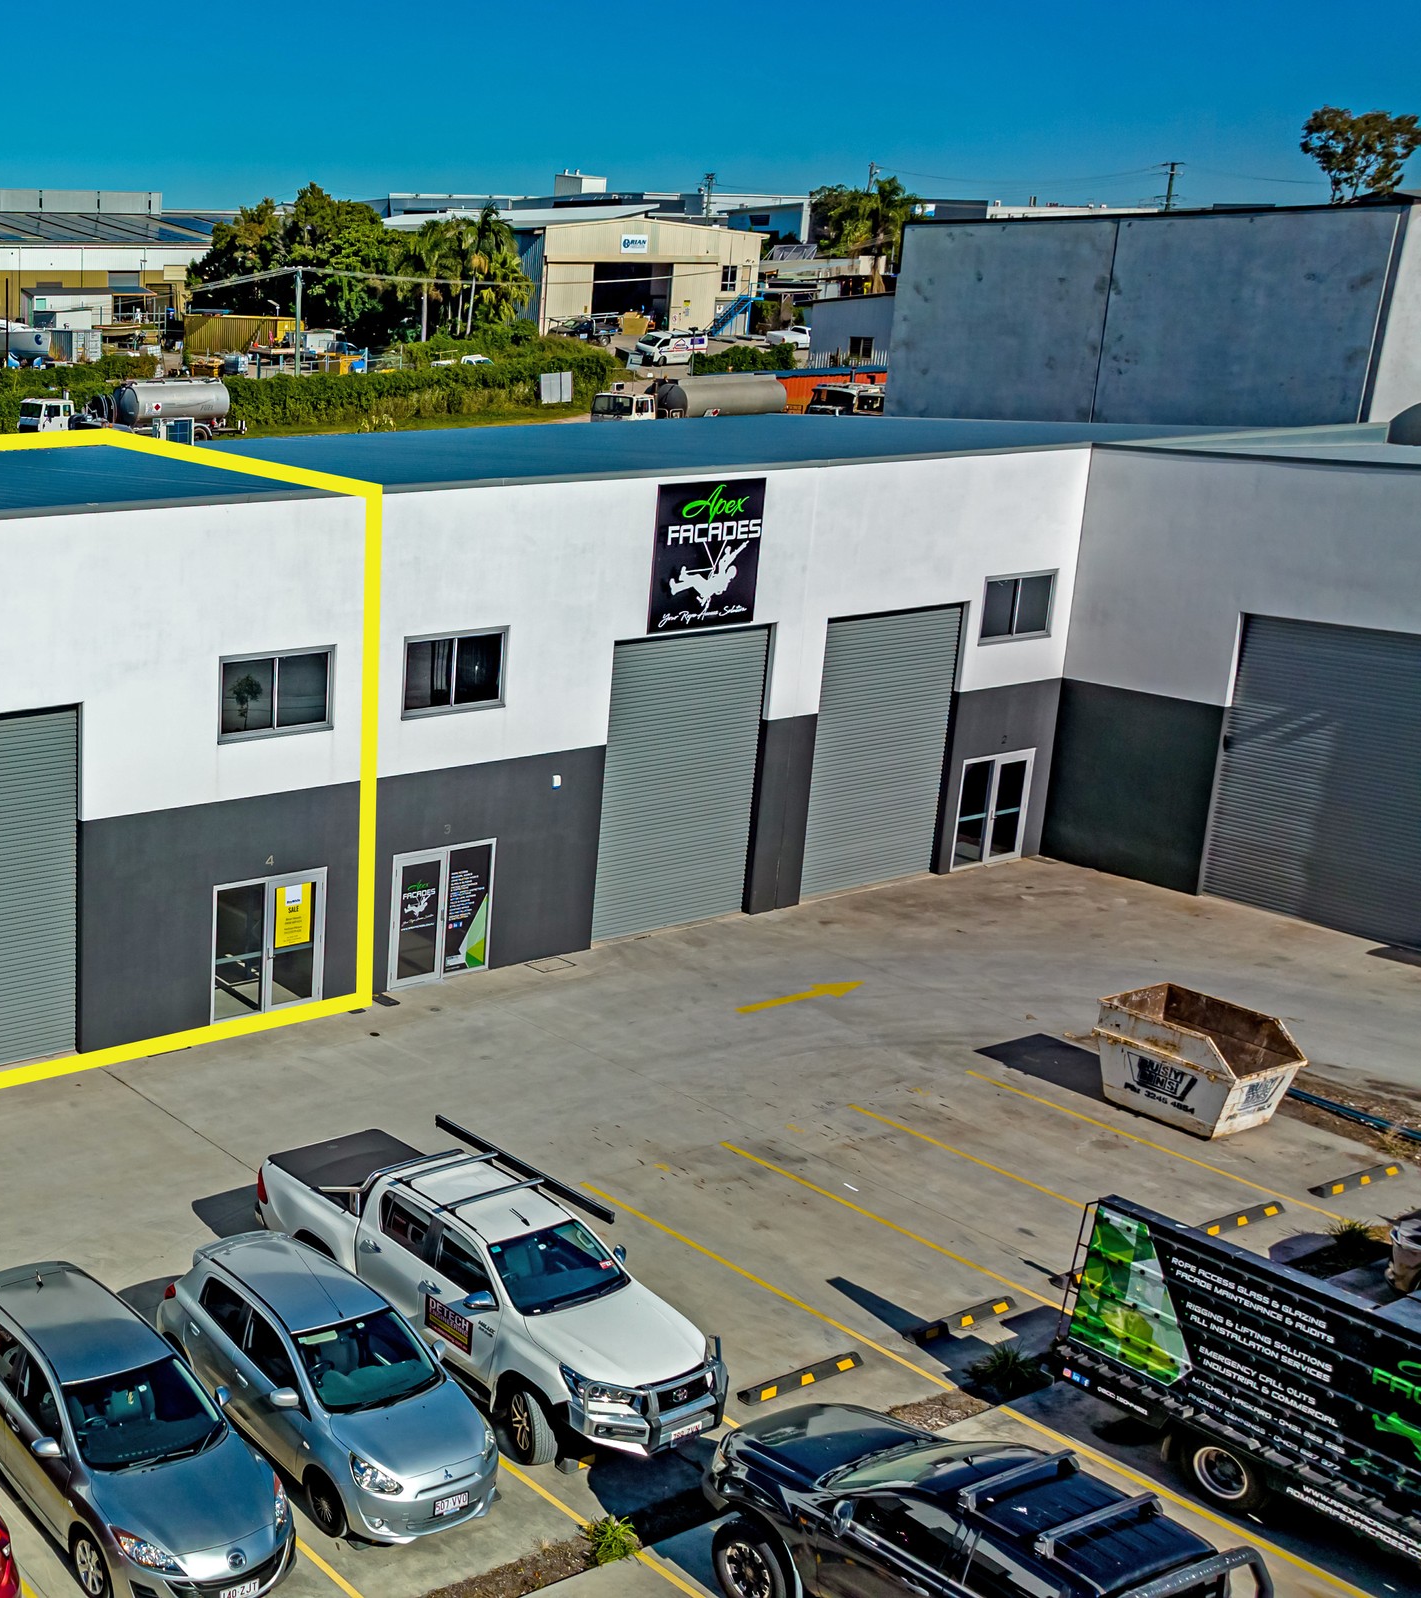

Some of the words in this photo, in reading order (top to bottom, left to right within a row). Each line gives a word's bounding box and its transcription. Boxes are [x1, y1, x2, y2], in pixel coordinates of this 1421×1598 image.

[682, 484, 750, 524] Apex
[667, 519, 762, 546] FACADES
[265, 855, 275, 866] 4
[288, 905, 299, 914] SALE
[403, 887, 436, 900] FACADES
[1171, 1256, 1197, 1274] ROPE
[1198, 1268, 1236, 1290] ACCESS
[1237, 1285, 1270, 1305] GLASS
[1271, 1299, 1280, 1309] &
[1281, 1304, 1327, 1330] GLAZING
[1175, 1269, 1212, 1291] FACADE
[1213, 1286, 1284, 1326] MAINTENANCE
[1284, 1317, 1294, 1326] &
[1295, 1321, 1335, 1345] AUDITS
[429, 1297, 469, 1332] DETECH
[1186, 1301, 1224, 1324] RIGGING
[1225, 1319, 1234, 1328] &
[1235, 1323, 1272, 1345] LIFTING
[1273, 1340, 1333, 1373] SOLUTIONS
[1190, 1313, 1209, 1328] ALL
[1209, 1323, 1279, 1359] INSTALLATION
[1281, 1355, 1331, 1383] SERVICES
[1192, 1376, 1230, 1400] MITCHELL
[1199, 1345, 1258, 1377] EMERGENCY
[1258, 1373, 1285, 1391] CALL
[1286, 1387, 1317, 1406] OUTS
[1203, 1358, 1259, 1390] INDUSTRIAL
[1260, 1386, 1270, 1395] &
[1271, 1391, 1339, 1428] COMMERCIAL
